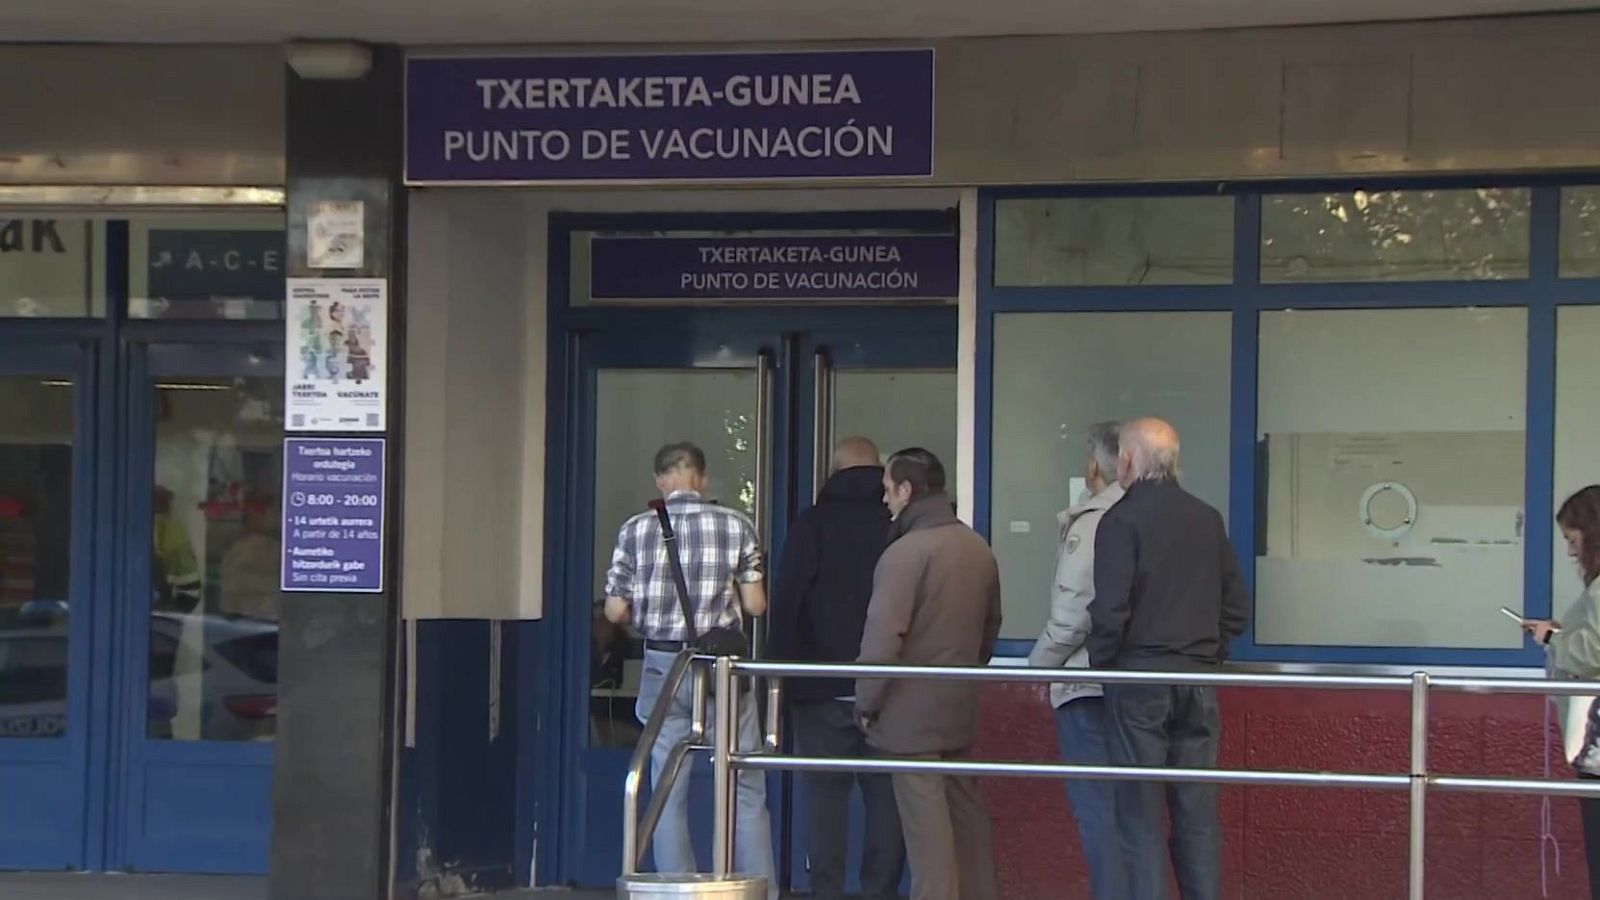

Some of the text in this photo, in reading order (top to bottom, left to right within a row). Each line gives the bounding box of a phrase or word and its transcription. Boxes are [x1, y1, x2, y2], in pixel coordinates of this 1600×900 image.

[476, 74, 862, 109] TXERTAKETA-GUNEA
[444, 118, 895, 162] PUNTO DE VACUNACIÓN
[698, 245, 902, 265] TXERTAKETA-GUNEA
[680, 267, 919, 291] PUNTO DE VACUNACIÓN
[337, 390, 379, 398] VACÚNATE
[298, 446, 372, 457] Txertoa hartzeko
[313, 460, 356, 471] ordutegia
[291, 472, 325, 482] Horario
[307, 494, 334, 505] 8:00
[344, 494, 377, 506] 20:00
[294, 516, 373, 527] 14 urtetik aurrera
[292, 529, 379, 540] A partir de 14 años
[342, 560, 366, 572] gabe
[292, 572, 357, 584] Sin cita previa
